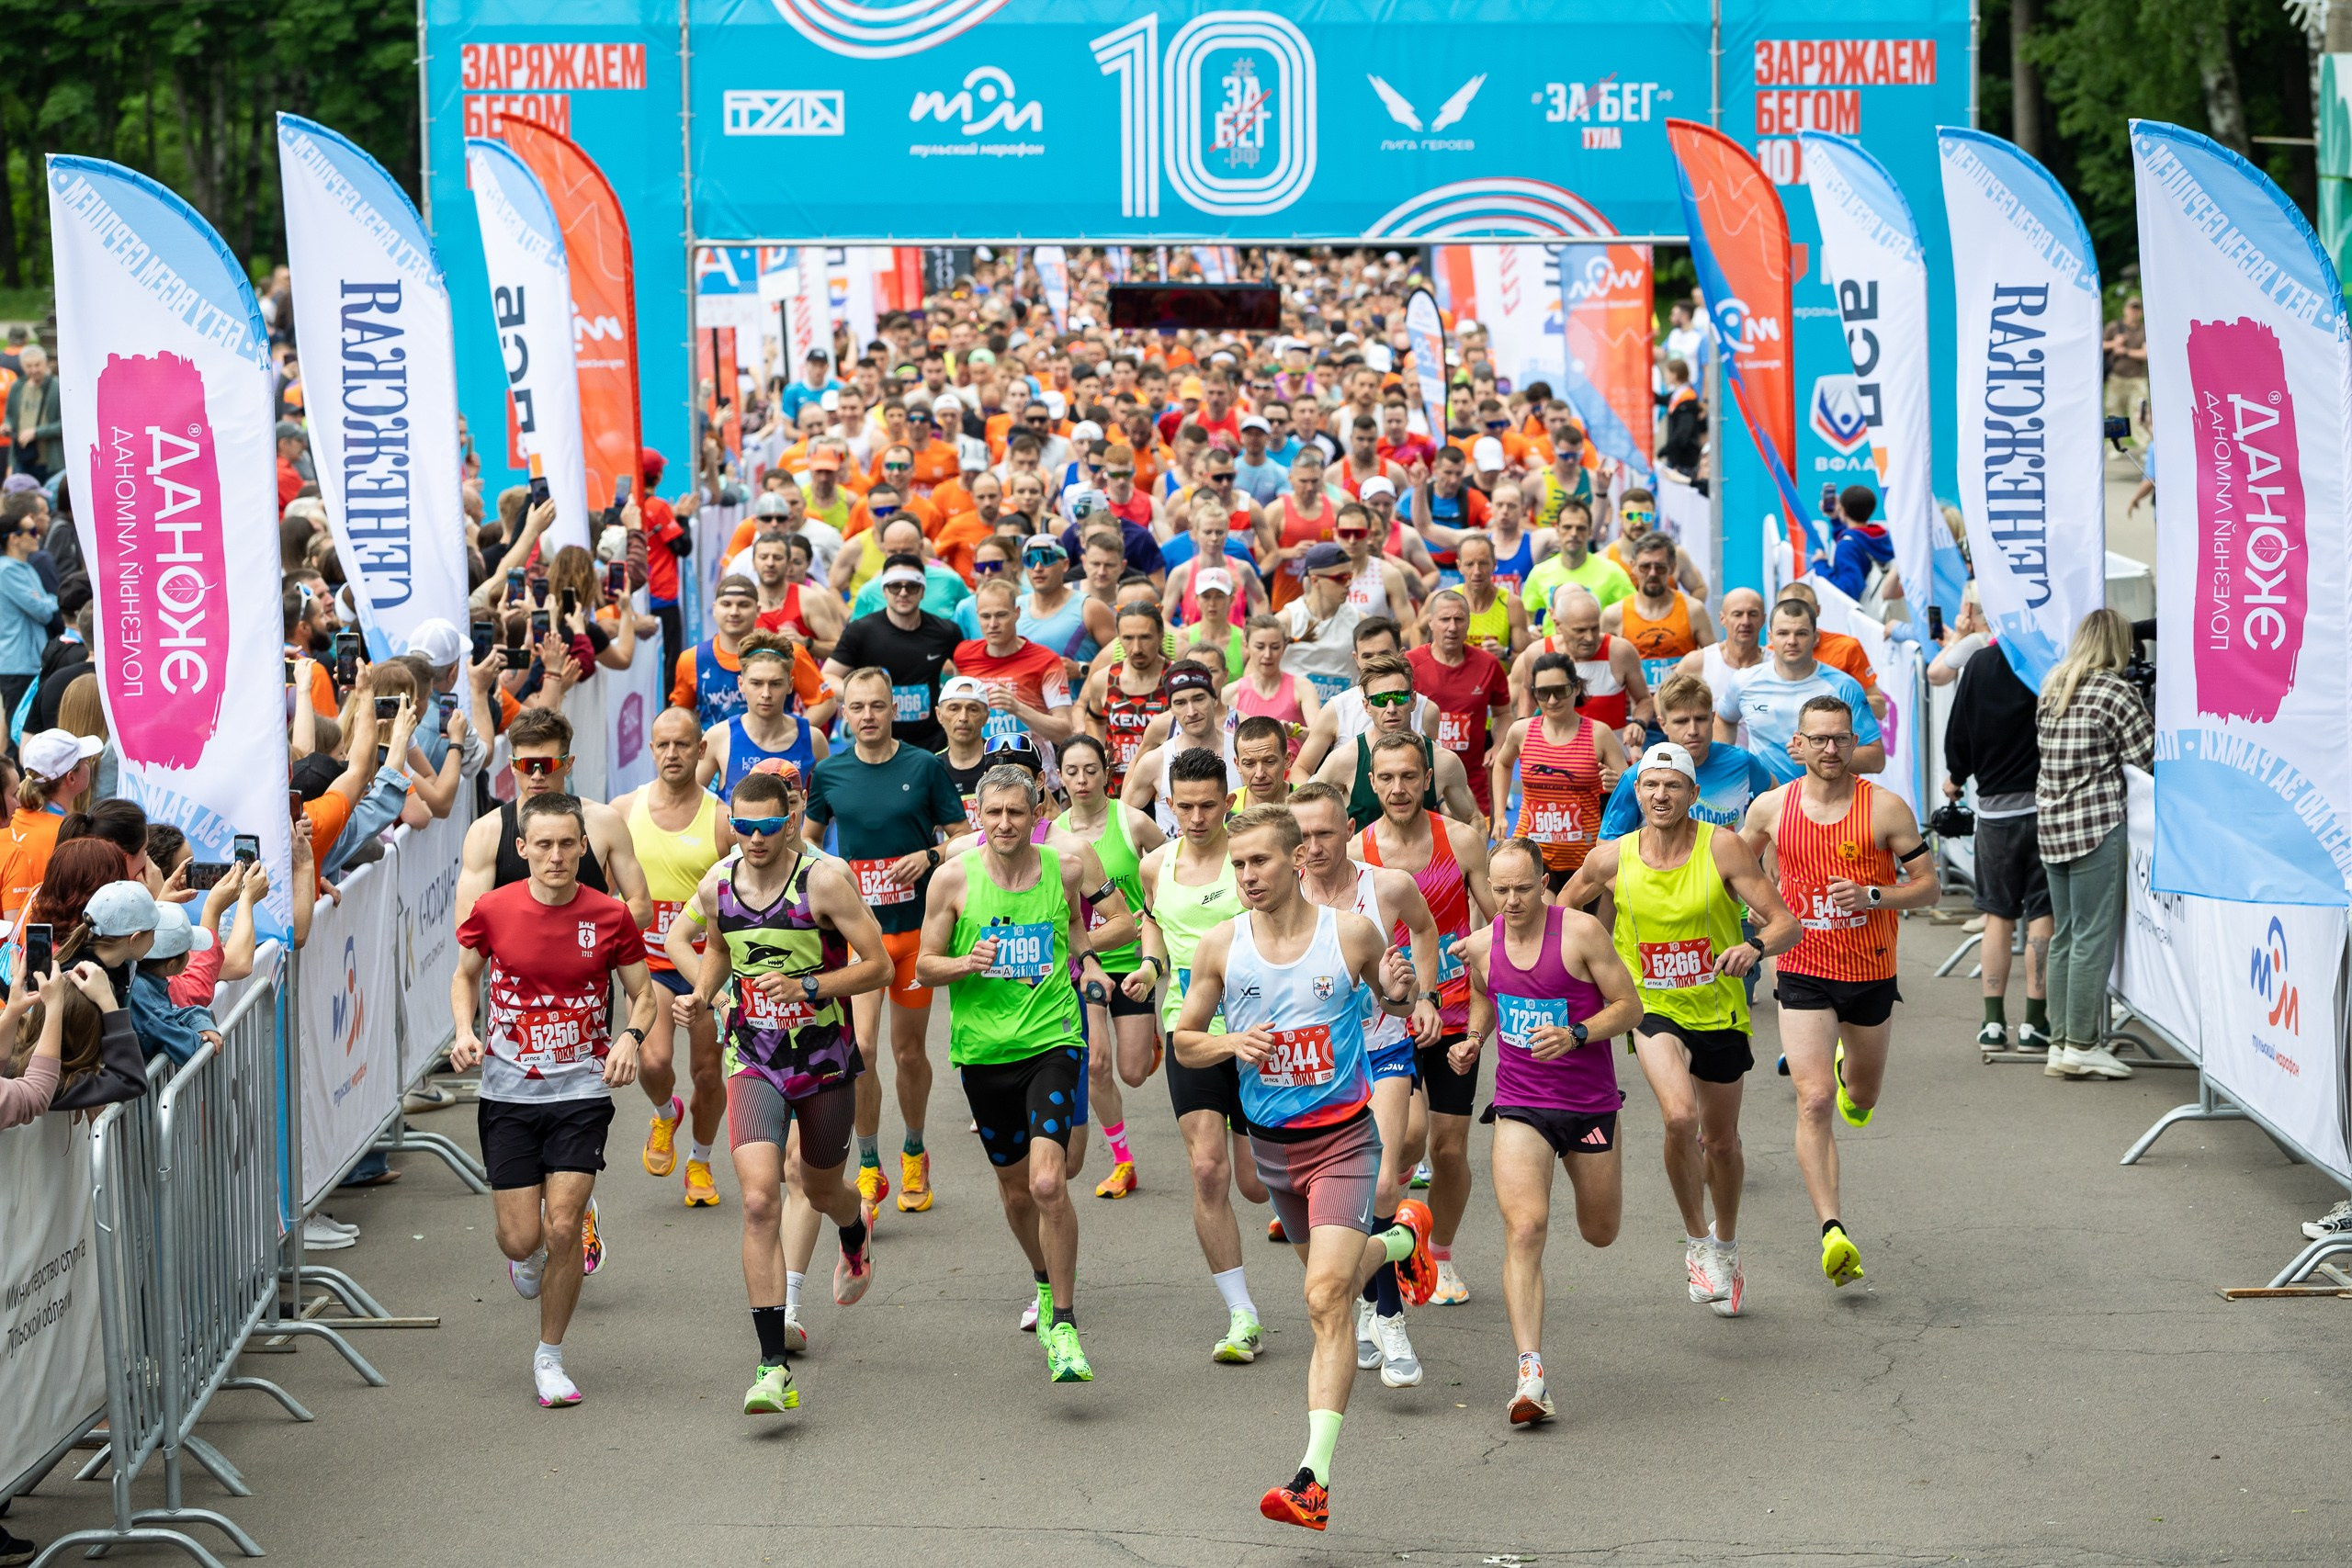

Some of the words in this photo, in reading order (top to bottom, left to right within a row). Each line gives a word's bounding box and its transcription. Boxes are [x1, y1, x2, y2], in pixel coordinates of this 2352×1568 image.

[462, 44, 645, 89] ЗАРЯЖАЕМ
[1756, 40, 1937, 85] ЗАРЯЖАЕМ
[1090, 10, 1317, 217] 10
[1756, 90, 1860, 135] БЕГОМ
[1380, 140, 1417, 151] ЛИГА
[1420, 140, 1475, 151] ГЕРОЕВ
[1815, 457, 1876, 471] ВФЛА
[1109, 713, 1156, 727] KENY
[1535, 811, 1572, 832] 5054
[861, 870, 901, 894] 522
[997, 936, 1040, 964] 7199
[1652, 950, 1701, 977] 5266
[530, 1021, 580, 1051] 5256
[1282, 1031, 1295, 1043] 10
[1269, 1041, 1320, 1073] 5244
[6, 1258, 59, 1313] Министерство
